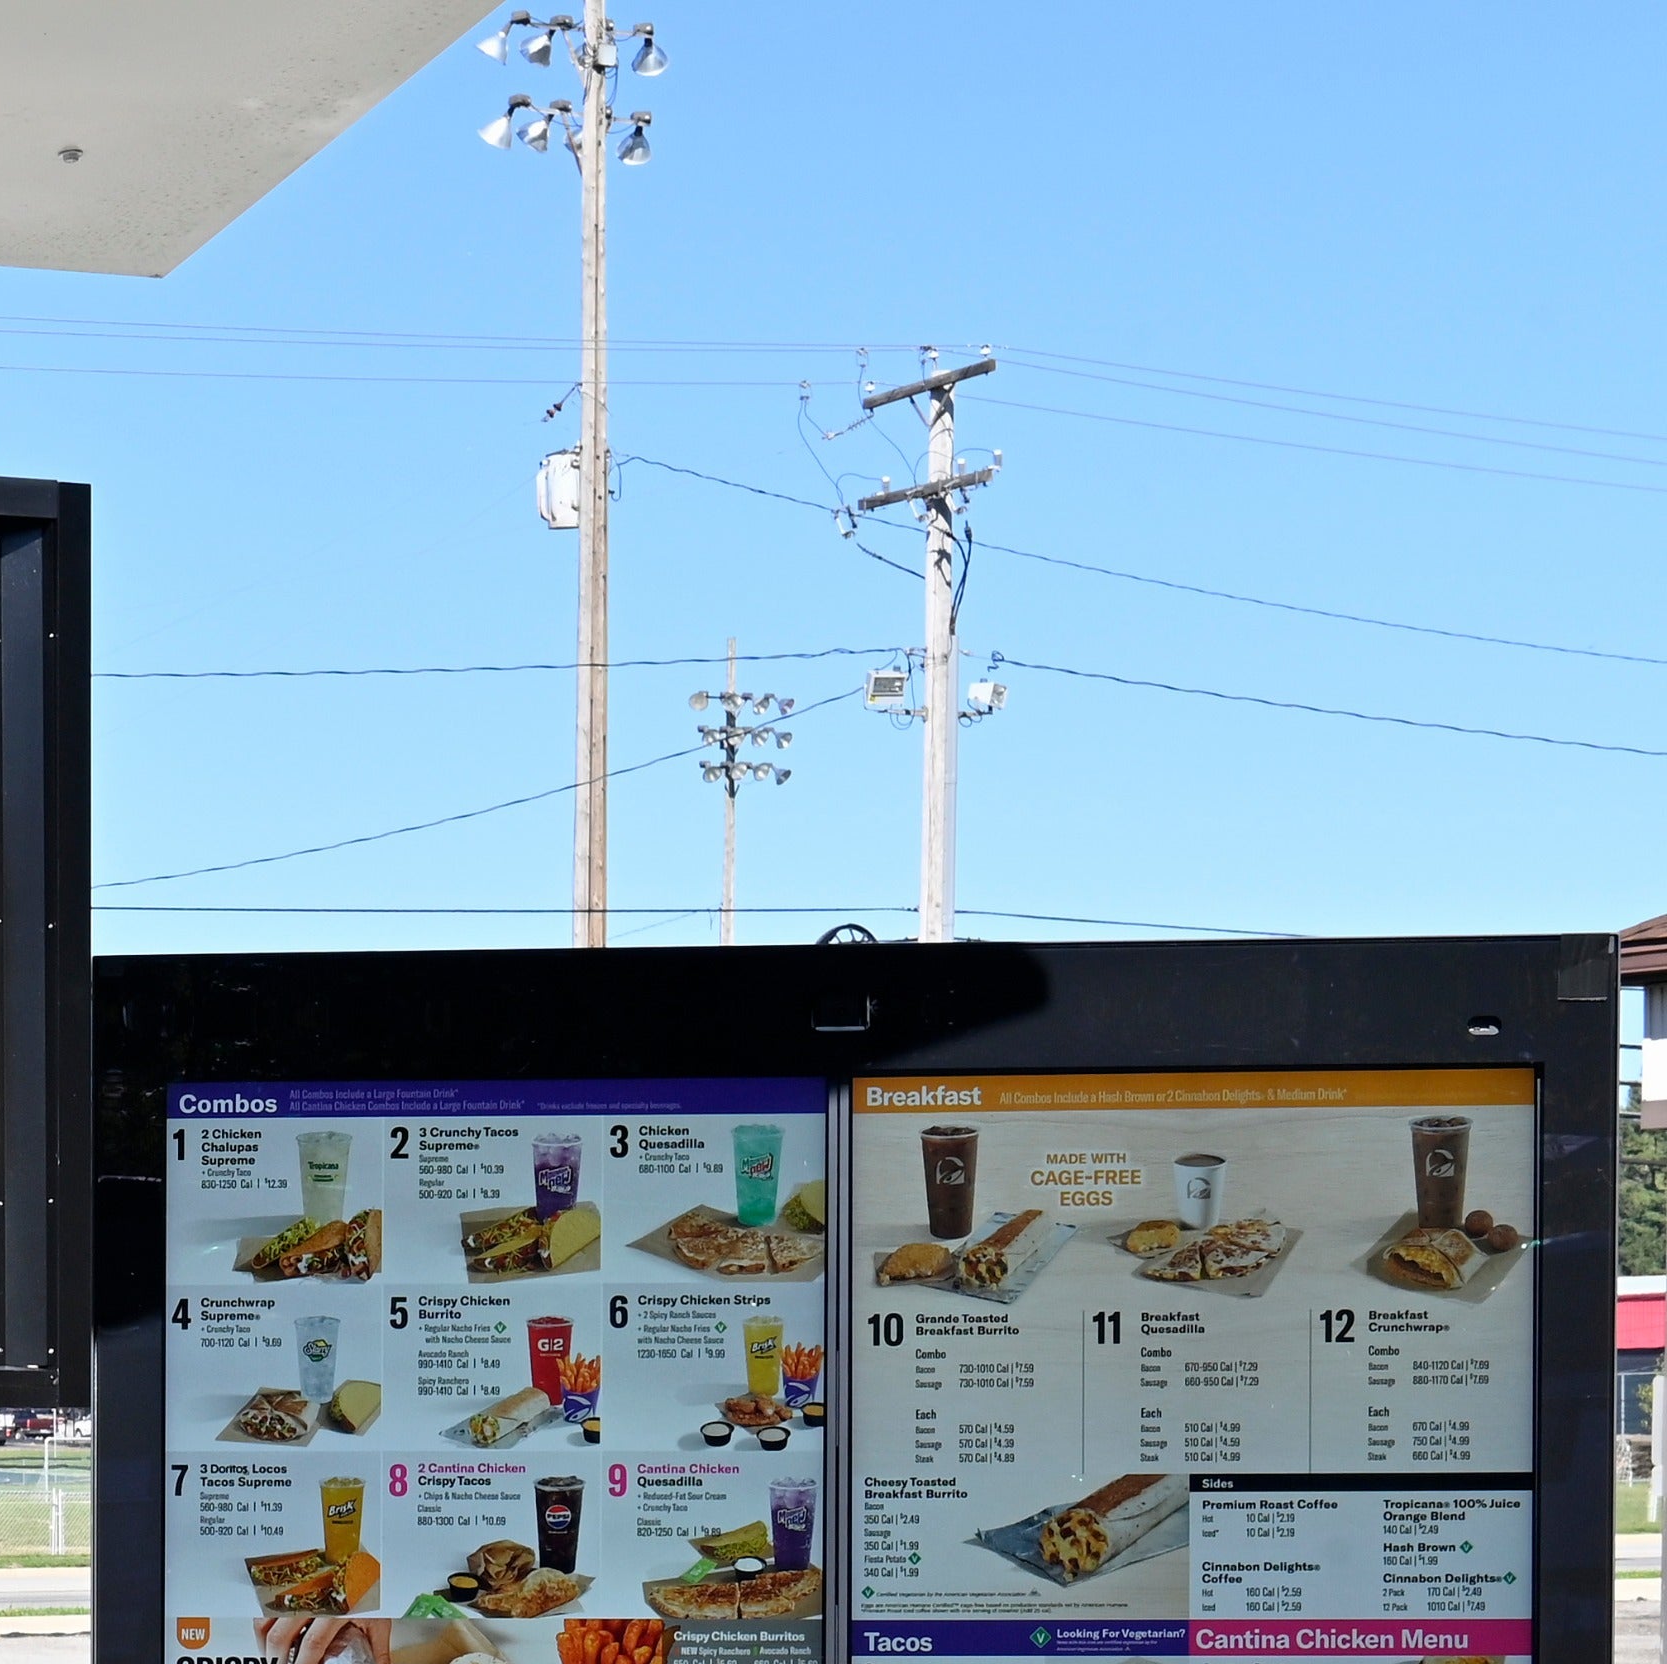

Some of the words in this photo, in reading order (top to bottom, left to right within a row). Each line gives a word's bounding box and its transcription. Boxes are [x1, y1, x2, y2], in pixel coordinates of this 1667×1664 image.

[867, 1086, 982, 1106] Breakfast
[179, 1094, 277, 1114] Combos
[201, 1129, 209, 1139] 2
[212, 1129, 261, 1139] Chicken
[419, 1128, 427, 1138] 3
[429, 1127, 481, 1139] Crunchy
[483, 1127, 519, 1138] Tacos
[639, 1126, 689, 1136] Chicken
[172, 1129, 185, 1160] 1
[390, 1126, 409, 1159] 2
[609, 1125, 629, 1158] 3
[639, 1139, 705, 1151] Quesadilla
[201, 1142, 258, 1154] Chalupas
[201, 1156, 255, 1167] Supreme
[1046, 1154, 1087, 1165] MADE
[1090, 1153, 1126, 1164] WITH
[1030, 1170, 1141, 1185] CAGE-FREE
[201, 1179, 237, 1189] 830-1250
[240, 1179, 253, 1189] Cal
[1060, 1191, 1113, 1206] EGGS
[200, 1298, 275, 1311] Crunchwrap
[418, 1296, 459, 1308] Crispy
[462, 1296, 510, 1306] Chicken
[638, 1295, 679, 1308] Crispy
[681, 1295, 730, 1306] Chicken
[734, 1295, 771, 1308] Strips
[171, 1298, 191, 1330] 4
[390, 1297, 408, 1329] 5
[418, 1309, 461, 1319] Burrito
[609, 1295, 629, 1328] 6
[1369, 1311, 1428, 1320] Breakfast
[916, 1315, 959, 1323] Grande
[962, 1314, 1008, 1323] Toasted
[868, 1313, 904, 1346] 10
[916, 1326, 974, 1335] Breakfast
[977, 1326, 1019, 1335] Burrito
[1092, 1311, 1121, 1344] 11
[1319, 1310, 1355, 1343] 12
[418, 1464, 426, 1474] 2
[428, 1464, 475, 1474] Cantina
[478, 1463, 526, 1474] Chicken
[638, 1464, 685, 1474] Cantina
[689, 1464, 739, 1474] Chicken
[171, 1464, 189, 1496] 7
[200, 1477, 235, 1487] Tacos
[238, 1477, 292, 1489] Supreme
[389, 1464, 408, 1496] 8
[418, 1476, 456, 1488] Crispy
[458, 1476, 491, 1486] Tacos
[608, 1464, 628, 1497] 9
[637, 1477, 703, 1488] Quesadilla
[1202, 1479, 1233, 1489] Sides
[1202, 1500, 1256, 1510] Premium
[1259, 1500, 1294, 1509] Roast
[1297, 1500, 1338, 1509] Coffee
[181, 1629, 205, 1640] NEW
[1056, 1629, 1099, 1640] Looking
[1102, 1629, 1120, 1638] For
[1121, 1628, 1186, 1641] Vegetarian?
[1196, 1628, 1290, 1649] Cantina
[1295, 1628, 1394, 1649] Chicken
[1401, 1629, 1469, 1649] Menu
[864, 1632, 933, 1652] Tacos
